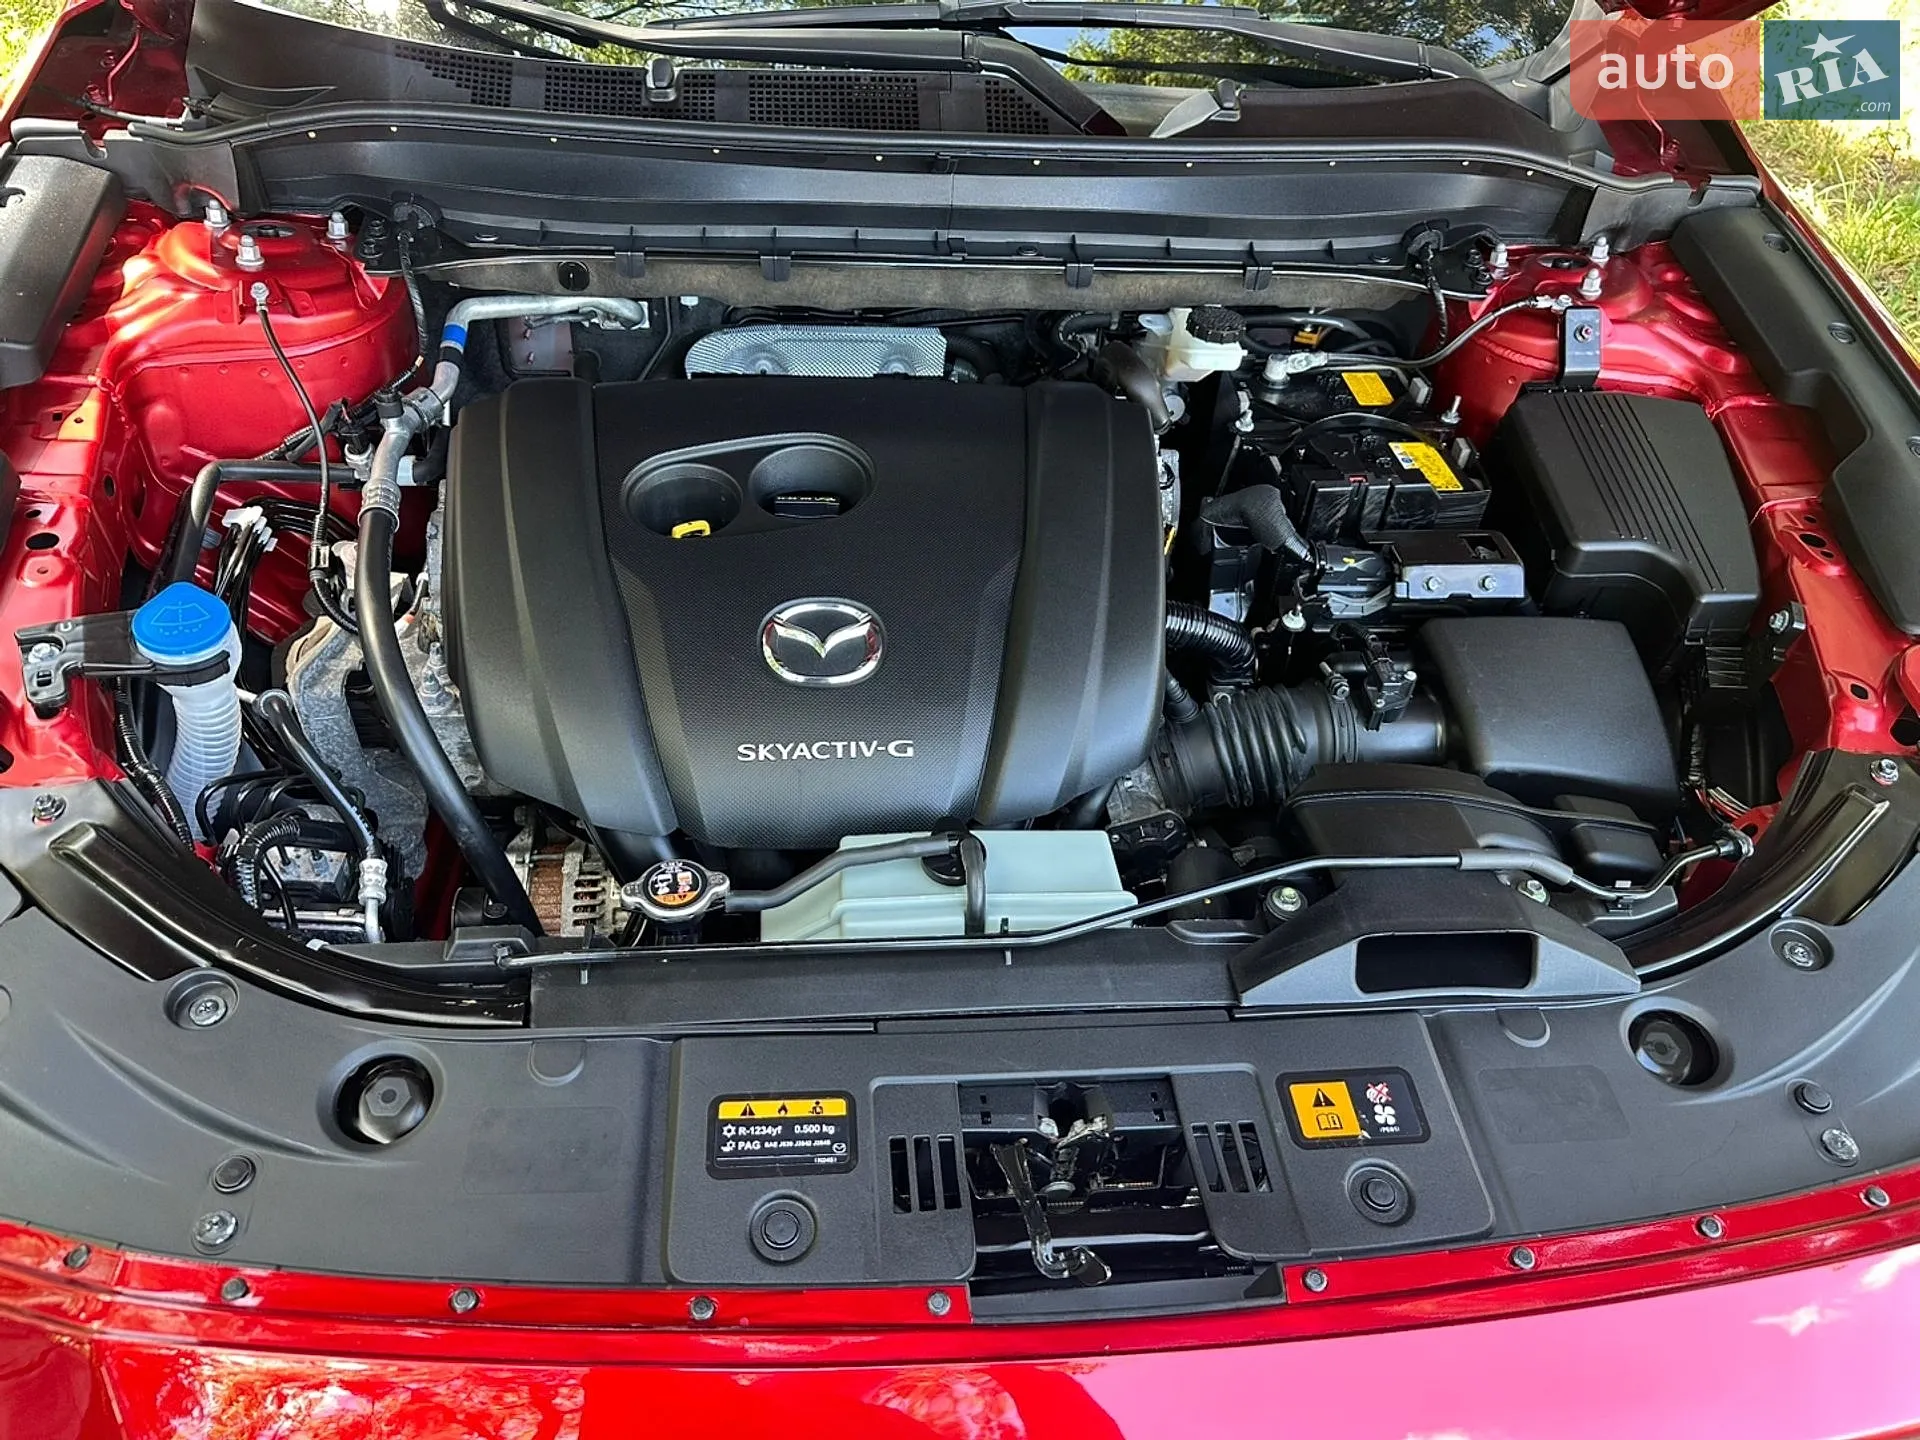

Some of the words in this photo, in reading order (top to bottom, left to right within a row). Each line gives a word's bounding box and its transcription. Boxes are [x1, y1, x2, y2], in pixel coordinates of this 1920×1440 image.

[737, 740, 914, 762] SKYACTIV-G
[738, 1125, 782, 1136] R-1234yf
[794, 1125, 820, 1134] 0.500
[822, 1124, 835, 1135] kg
[738, 1140, 761, 1151] PAG
